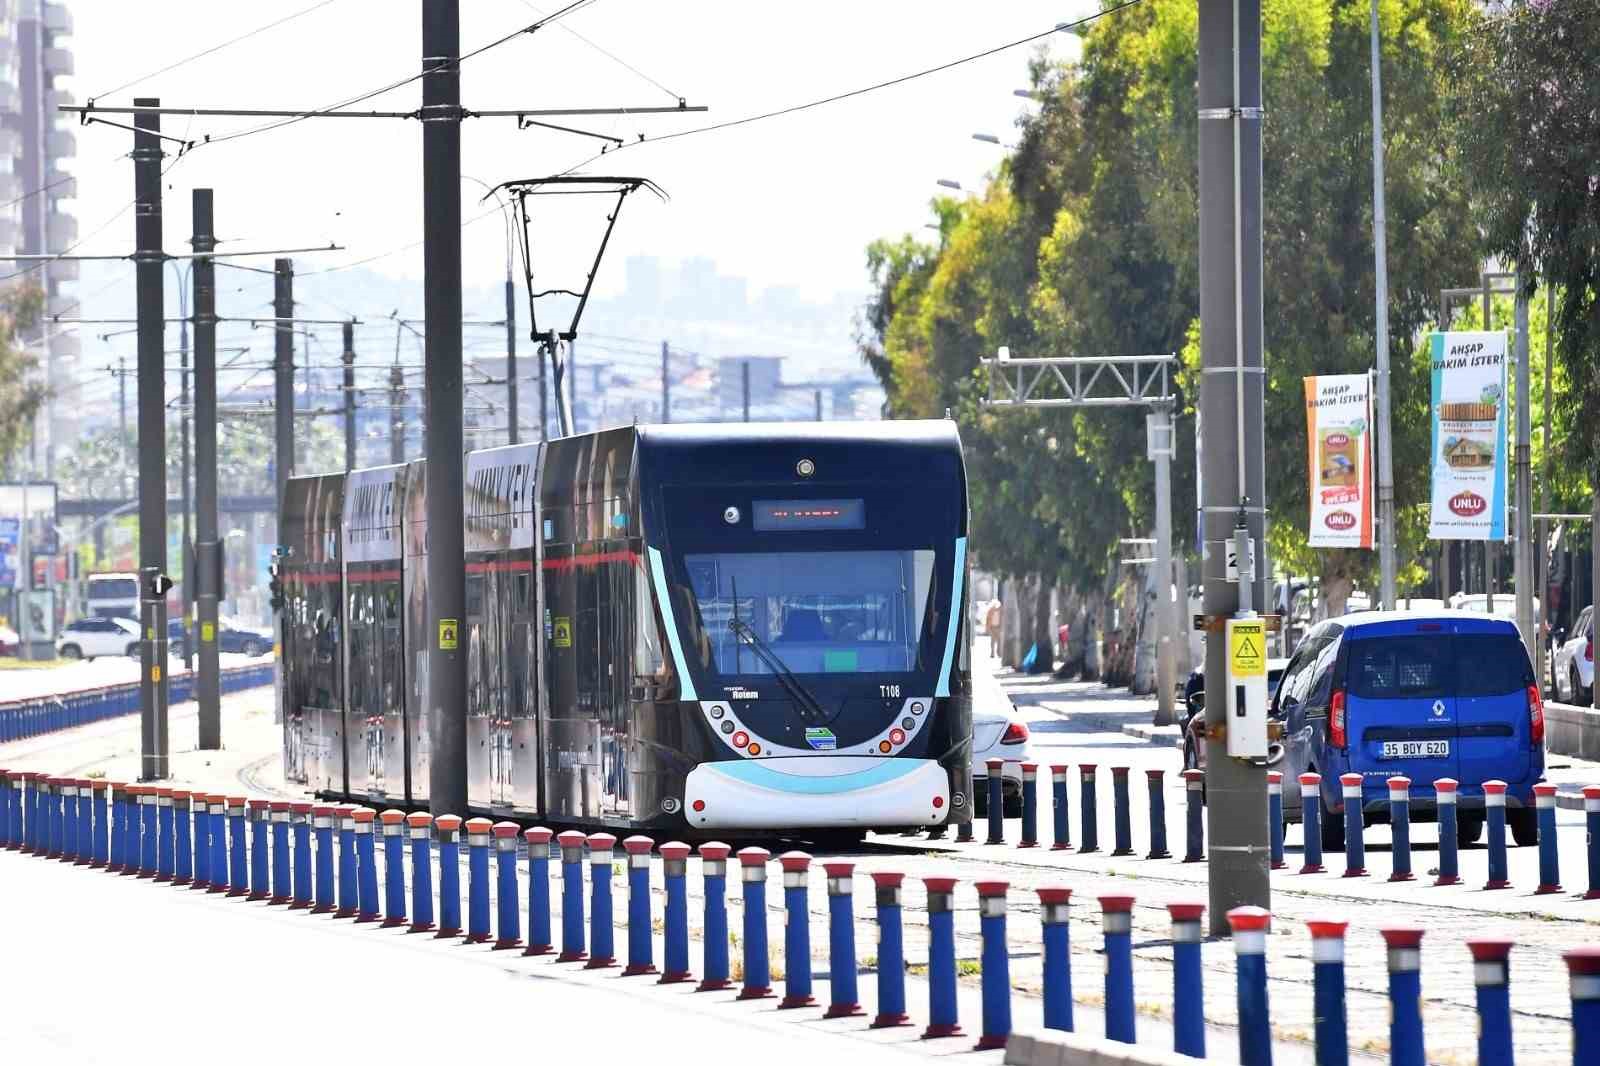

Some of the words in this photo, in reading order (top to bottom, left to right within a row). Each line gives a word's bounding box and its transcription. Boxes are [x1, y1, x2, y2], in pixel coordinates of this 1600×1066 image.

[1450, 343, 1484, 356] AHŞAP
[732, 691, 759, 700] Rotem
[879, 684, 901, 698] T108
[1385, 743, 1398, 755] 35
[1426, 742, 1446, 754] 620
